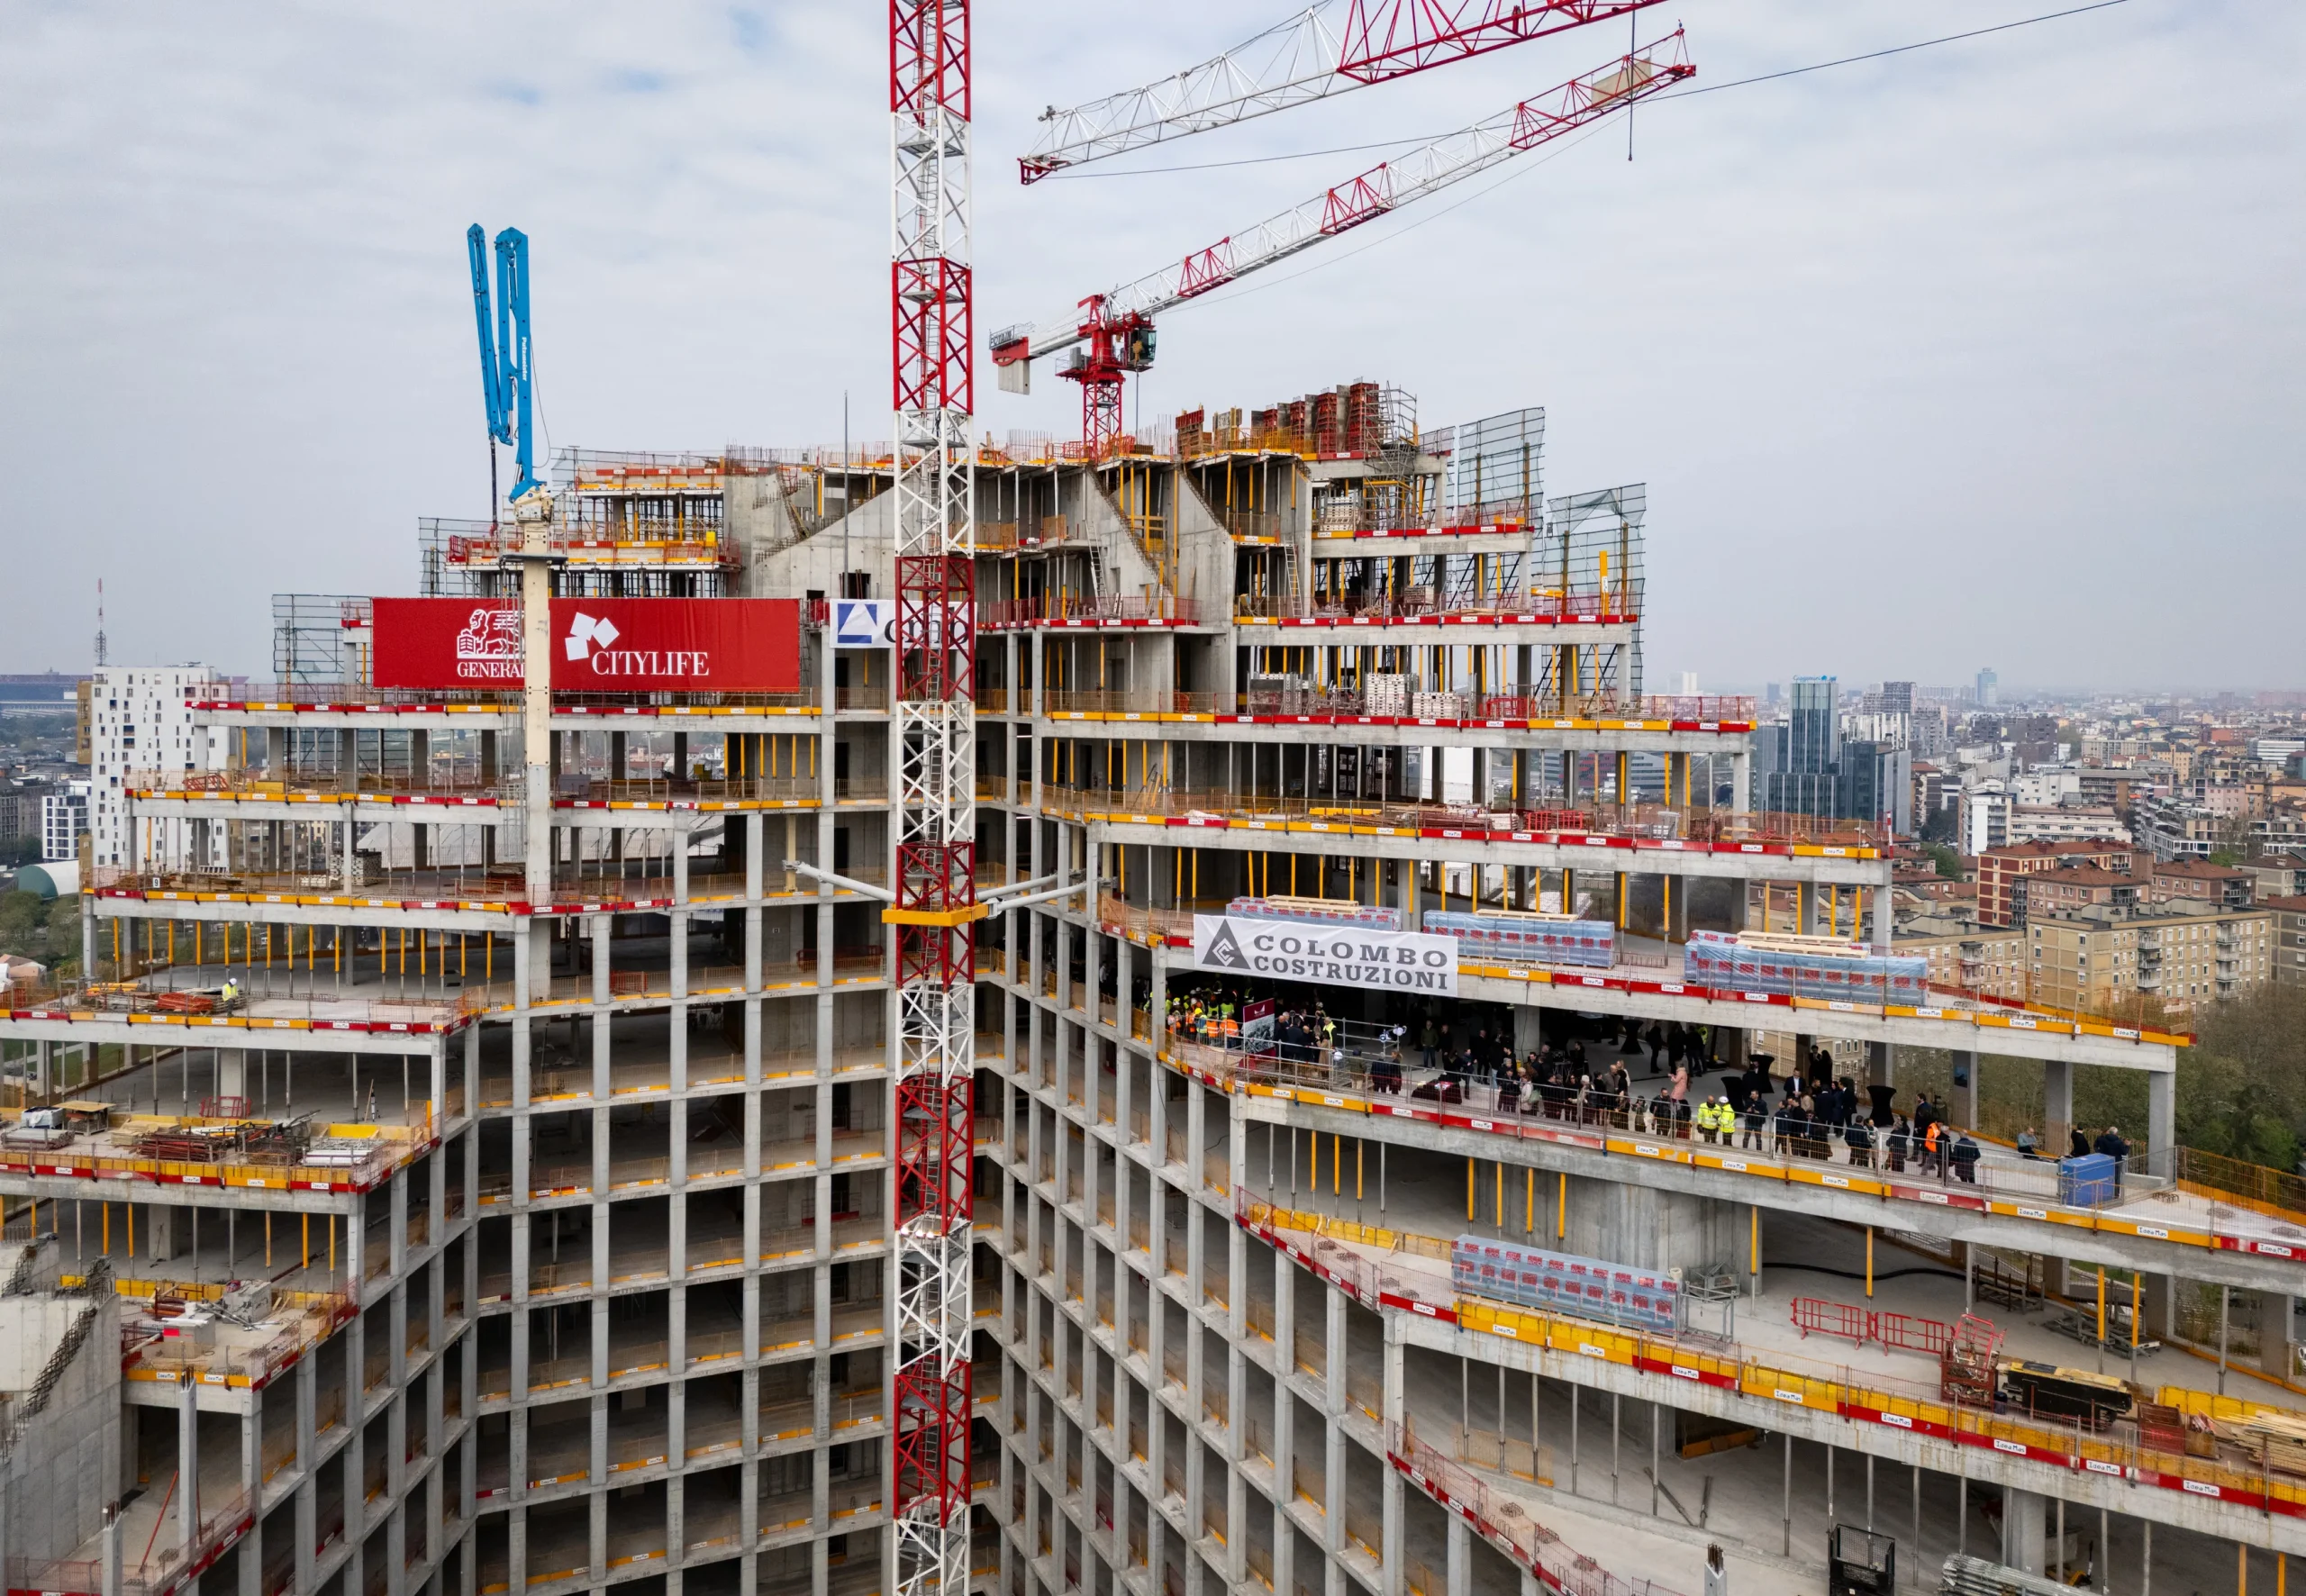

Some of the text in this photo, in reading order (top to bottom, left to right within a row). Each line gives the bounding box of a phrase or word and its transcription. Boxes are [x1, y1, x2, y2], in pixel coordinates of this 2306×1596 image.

[456, 661, 525, 678] GENERAL
[591, 650, 710, 676] CITYLIFE
[1253, 934, 1448, 968] COLOMBO
[1253, 955, 1448, 990] COSTRUZIONI
[1883, 1414, 1911, 1426] Idea Mas
[1995, 1441, 2025, 1453] Idea Mas
[2089, 1461, 2119, 1474] Idea Mas
[2185, 1482, 2219, 1495] Idea Mas
